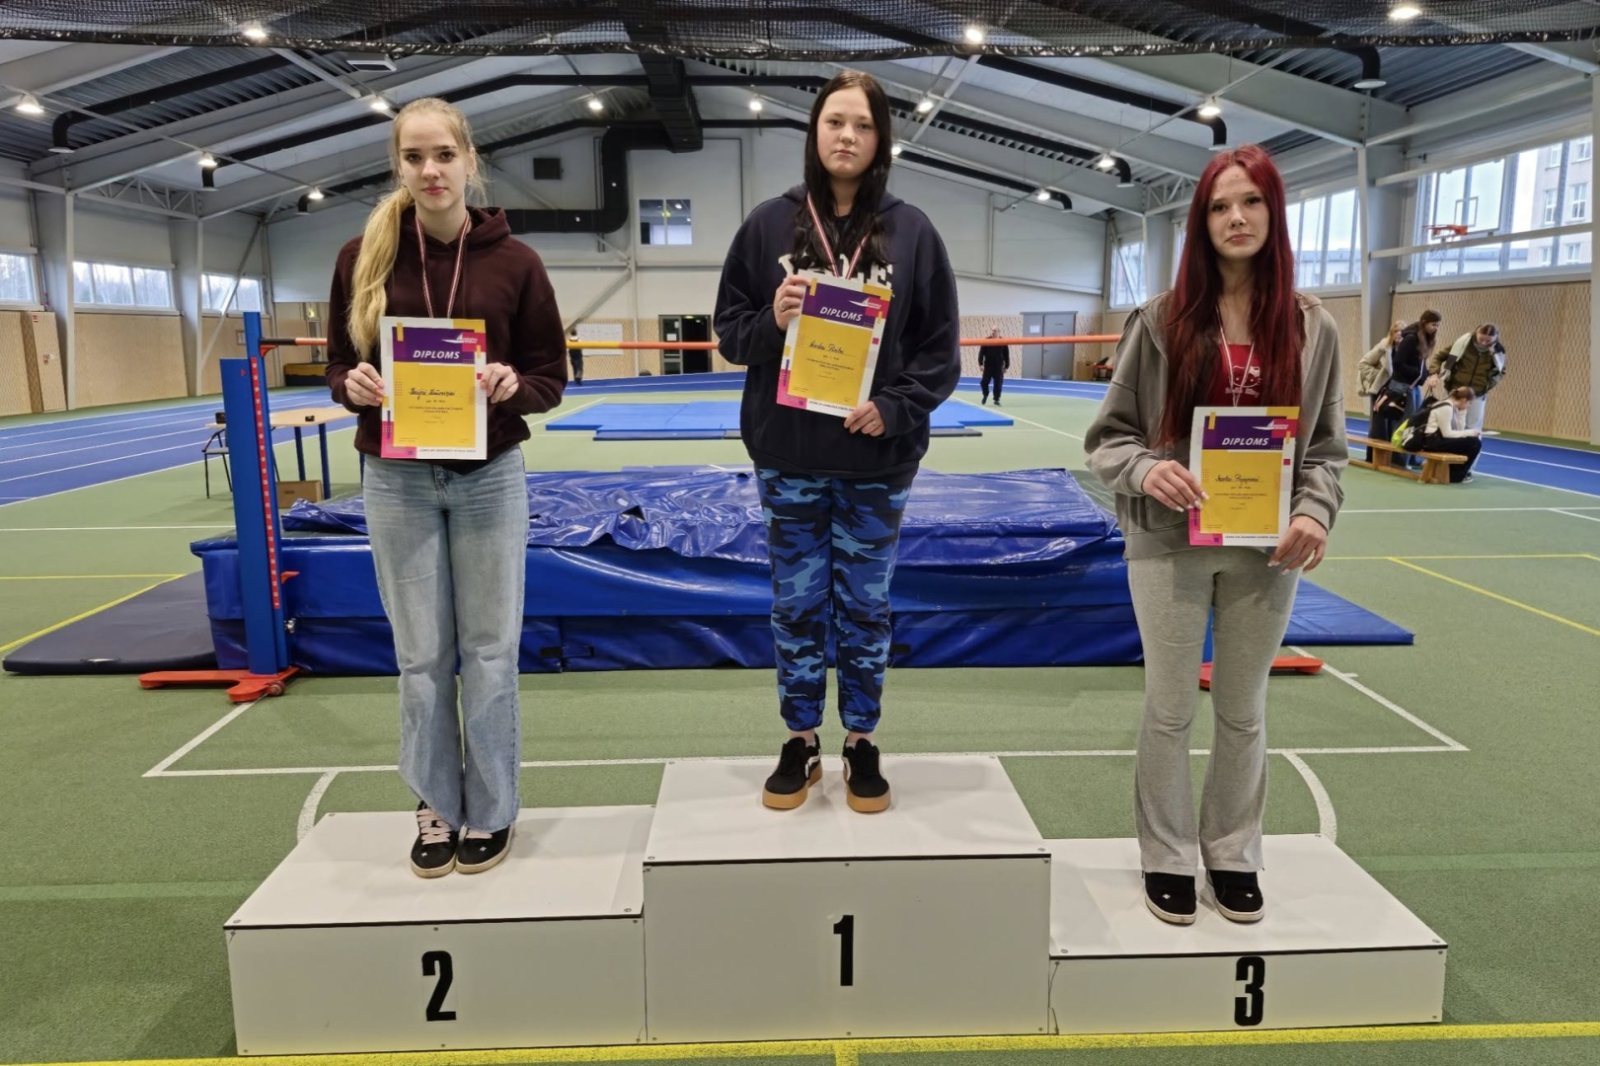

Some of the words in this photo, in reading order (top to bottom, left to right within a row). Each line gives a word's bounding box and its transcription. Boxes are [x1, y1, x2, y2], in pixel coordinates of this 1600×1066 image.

[820, 306, 863, 322] DIPLOMS
[413, 350, 460, 360] DIPLOMS
[1222, 437, 1269, 446] DIPLOMS
[834, 915, 853, 986] 1
[422, 951, 456, 1021] 2
[1235, 956, 1265, 1026] 3
